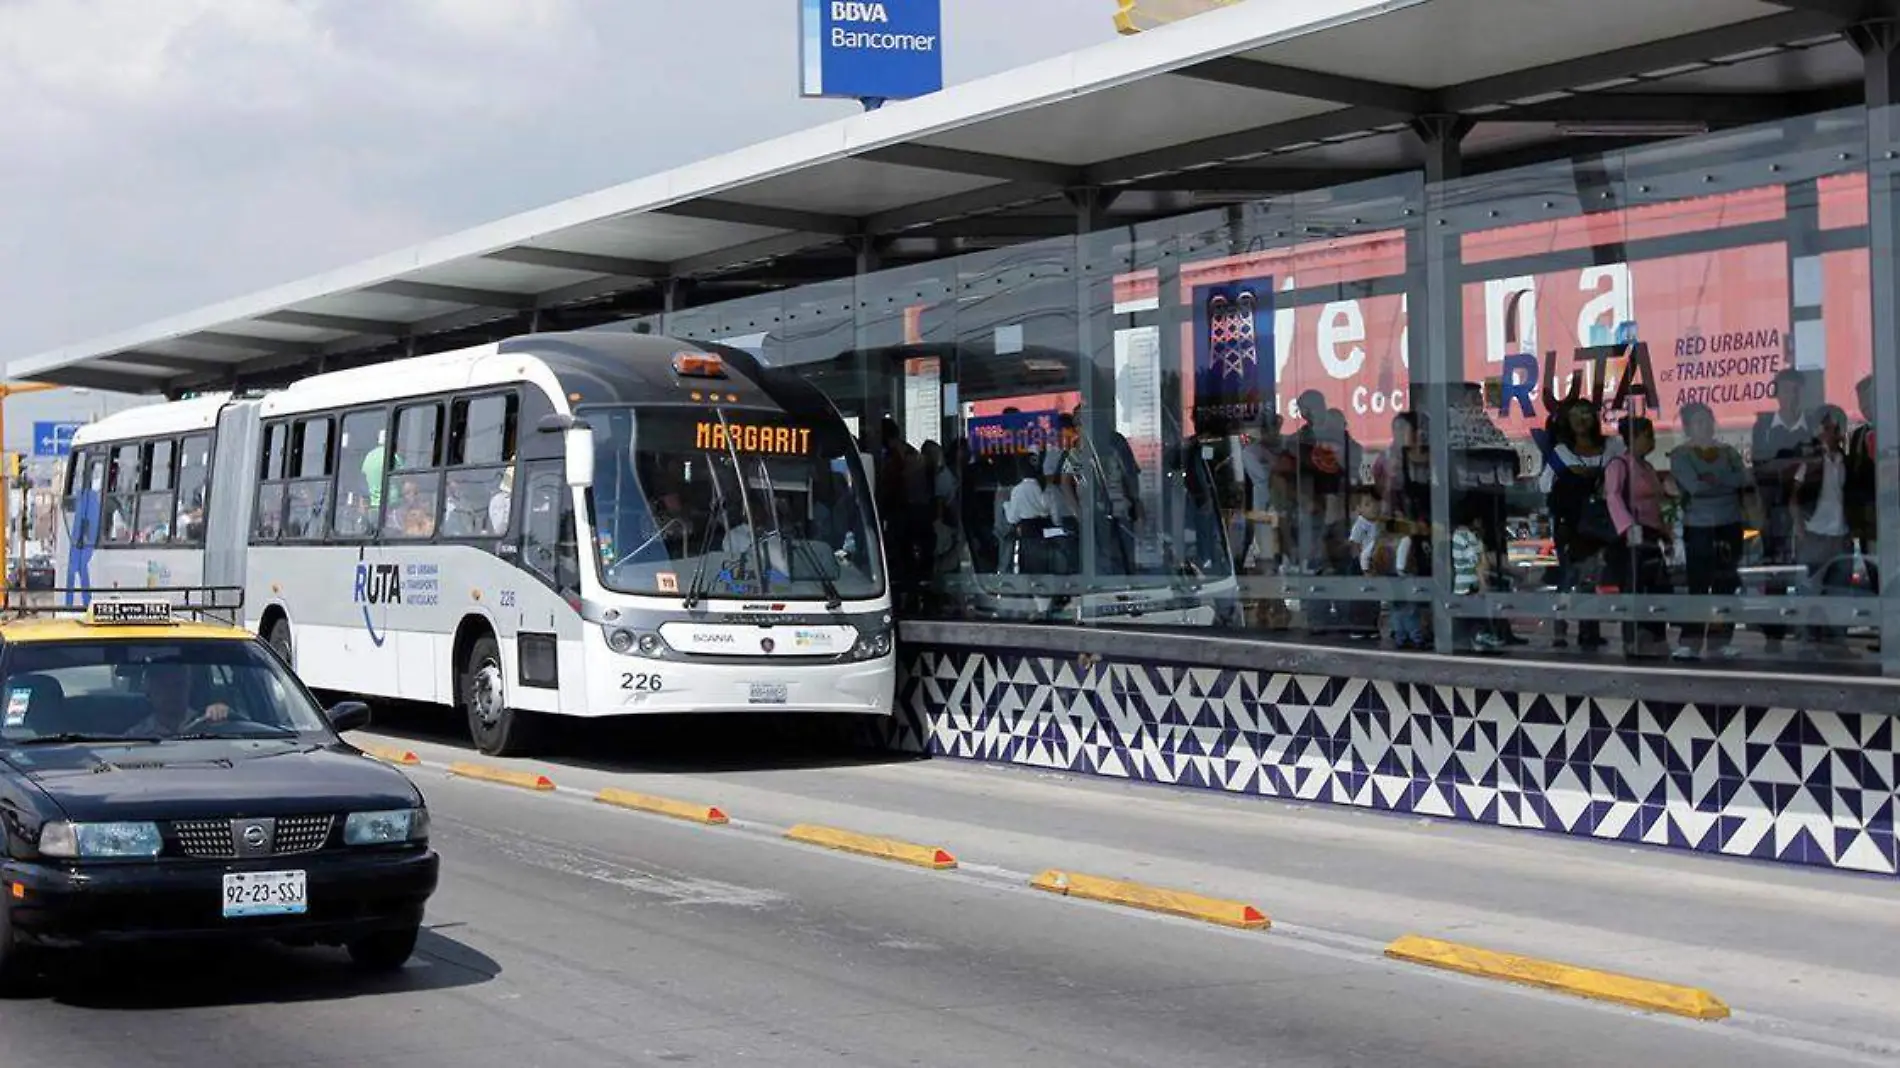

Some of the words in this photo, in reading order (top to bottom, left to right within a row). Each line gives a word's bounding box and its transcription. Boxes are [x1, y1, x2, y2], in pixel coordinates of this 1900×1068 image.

[831, 1, 888, 22] BBVA
[832, 28, 935, 50] Bancomer
[1675, 338, 1706, 357] RED
[1711, 328, 1779, 353] URBANA
[1499, 341, 1660, 417] RUTA
[1660, 370, 1674, 382] DE
[1676, 354, 1779, 380] TRANSPORTE
[1676, 381, 1778, 405] ARTICULADO
[696, 422, 811, 454] MARGARIT
[354, 564, 401, 604] RUTA
[500, 591, 515, 607] 226
[692, 633, 735, 644] SCANIA
[620, 672, 663, 691] 226
[226, 881, 304, 903] 92-23-SSJ
